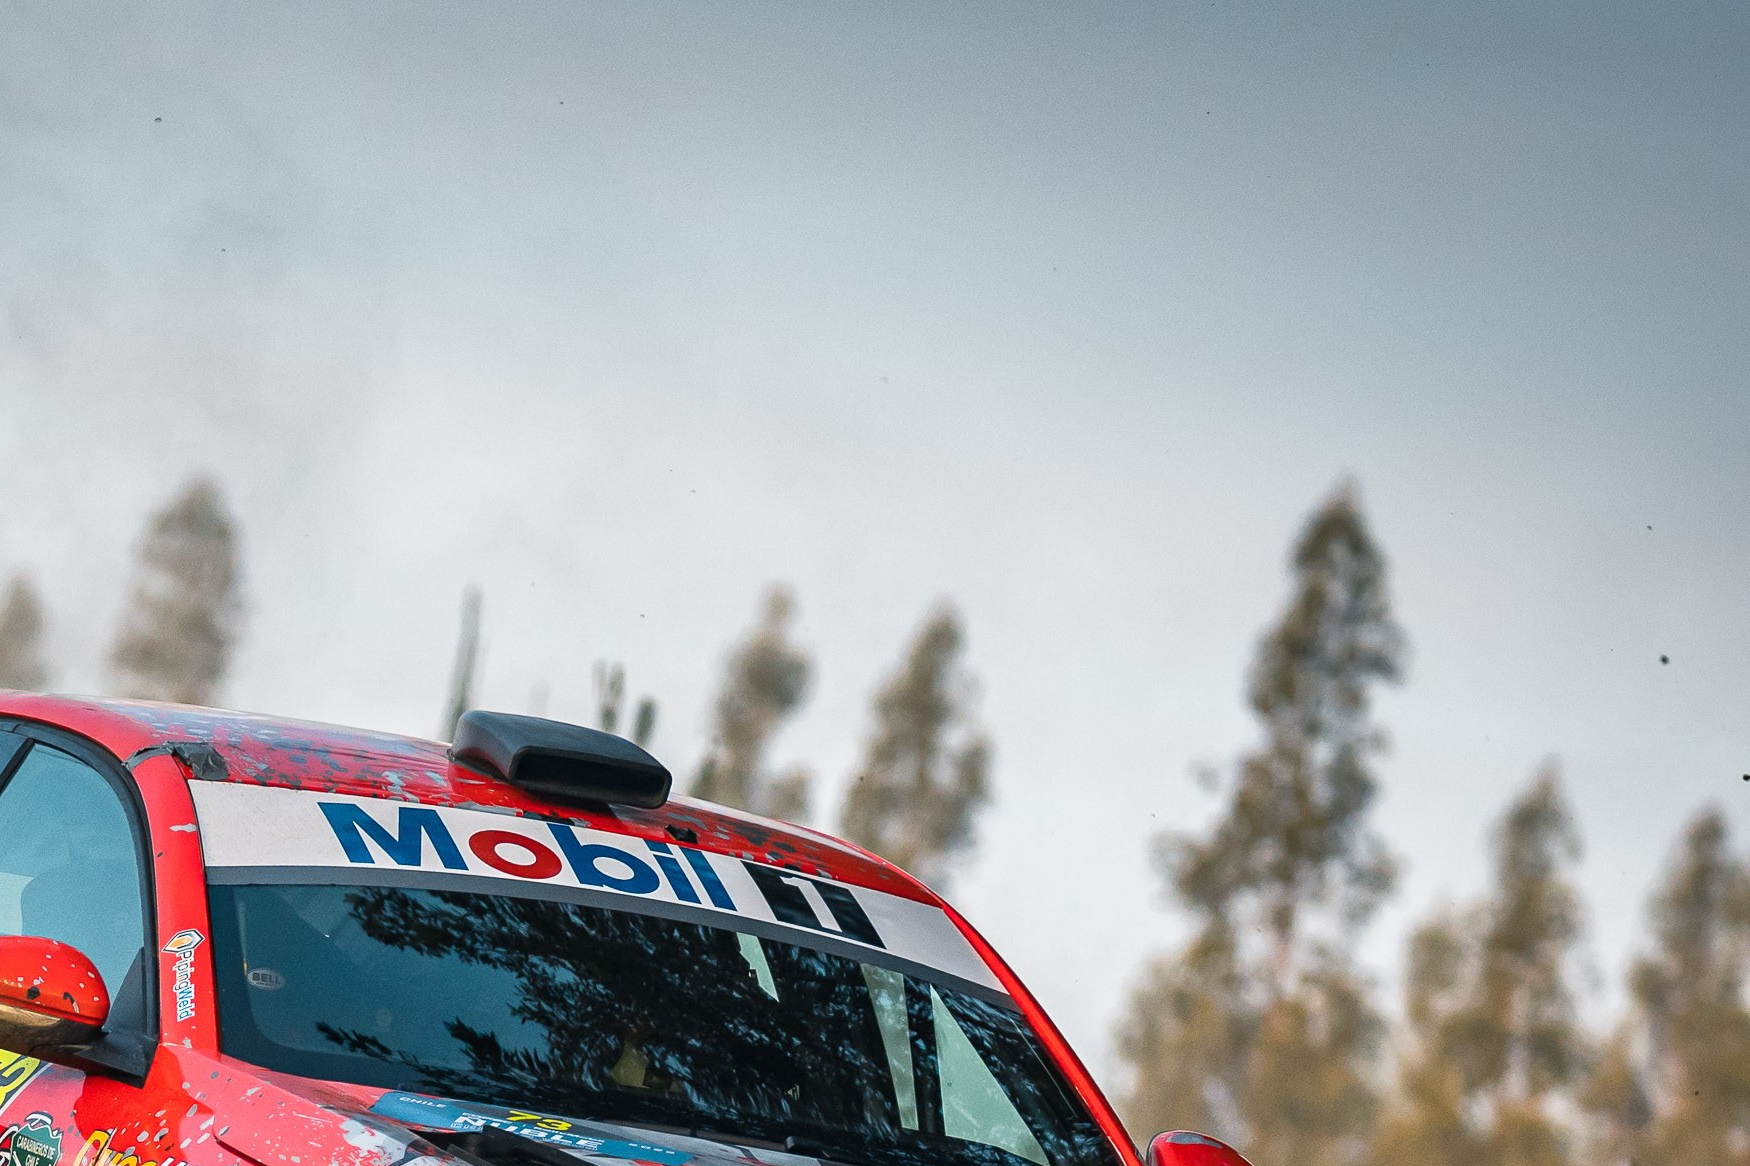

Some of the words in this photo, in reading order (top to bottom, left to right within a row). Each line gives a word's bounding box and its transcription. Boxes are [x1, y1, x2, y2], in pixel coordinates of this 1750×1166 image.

[317, 802, 739, 912] Mobil
[173, 949, 194, 1021] PipingWeld
[252, 972, 280, 985] BELL
[506, 1109, 573, 1131] 73
